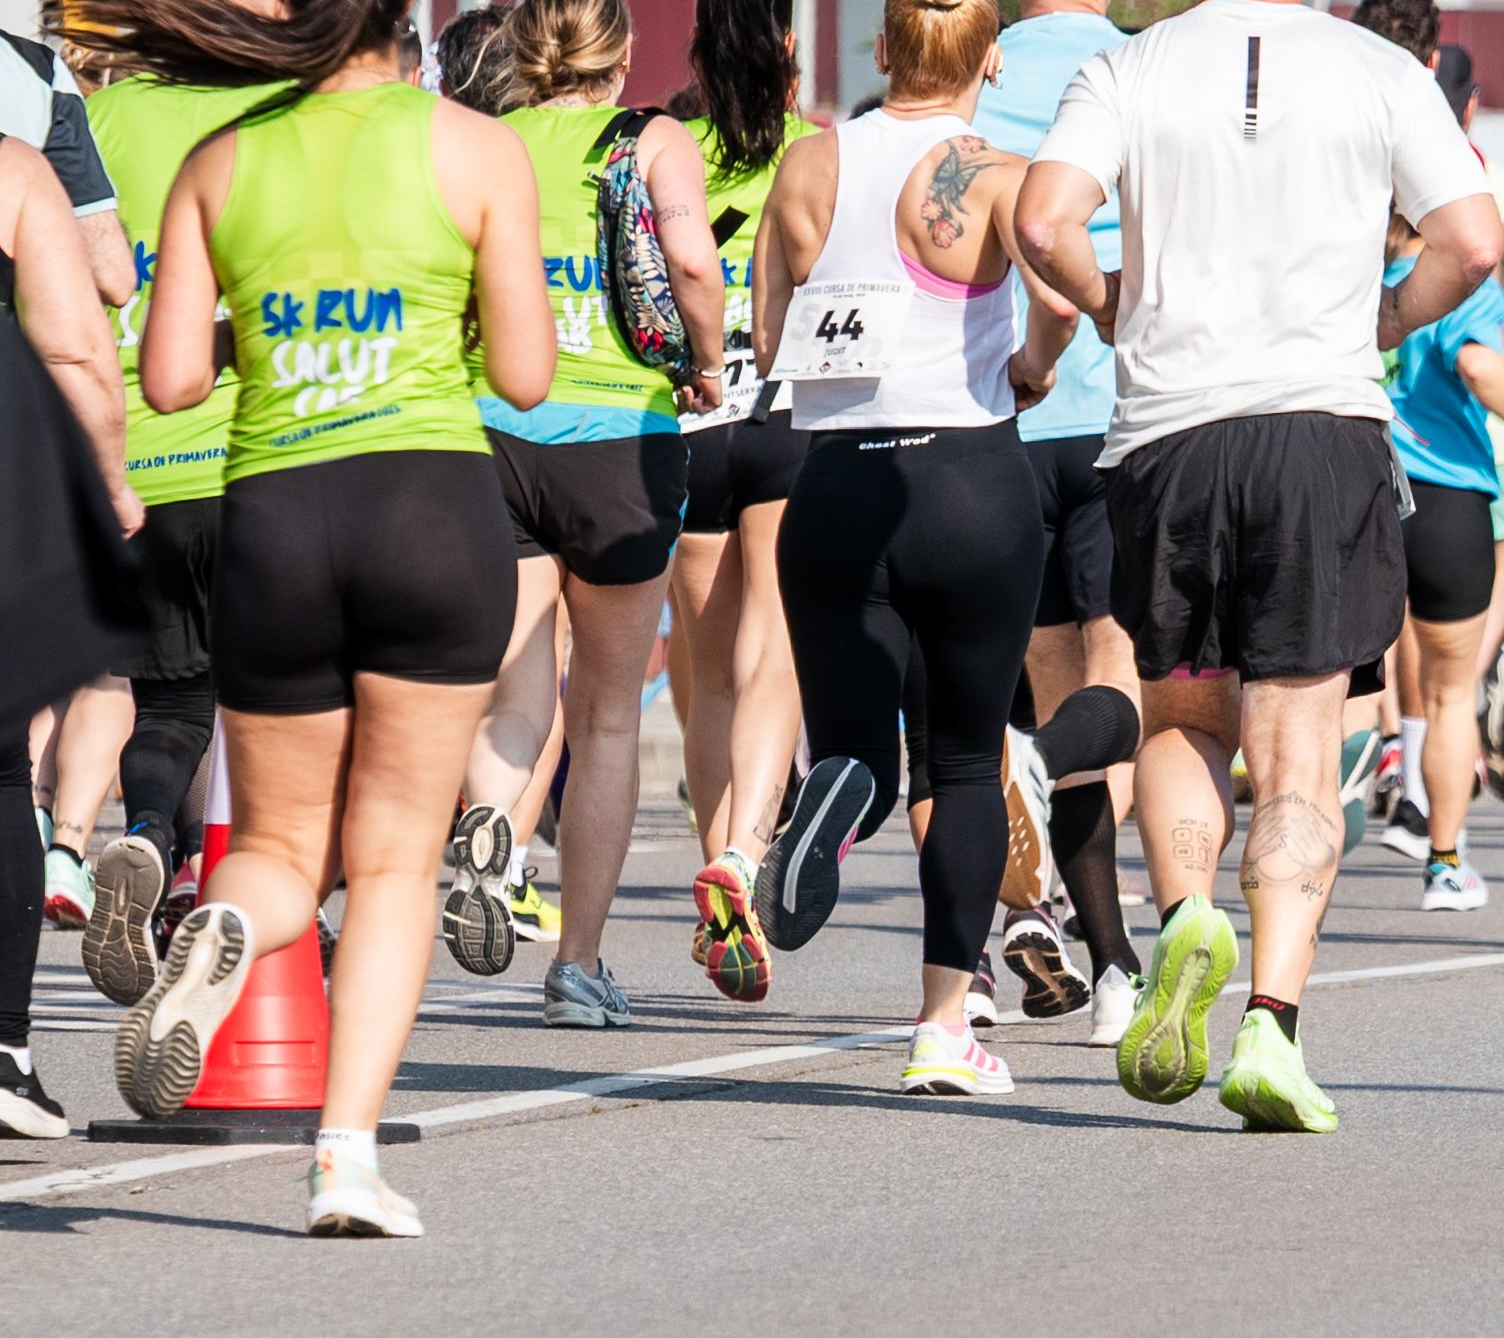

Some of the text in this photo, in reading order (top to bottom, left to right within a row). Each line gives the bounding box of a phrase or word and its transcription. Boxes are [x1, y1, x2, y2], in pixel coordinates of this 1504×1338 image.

[134, 241, 157, 291] k
[823, 283, 845, 294] CURSA
[846, 283, 856, 292] DE
[857, 282, 901, 294] PRIMAVERA
[314, 287, 403, 334] RUN
[815, 307, 865, 344] 44
[271, 336, 399, 388] SALUT
[125, 446, 227, 471] CURSA DE PRIMAVERA
